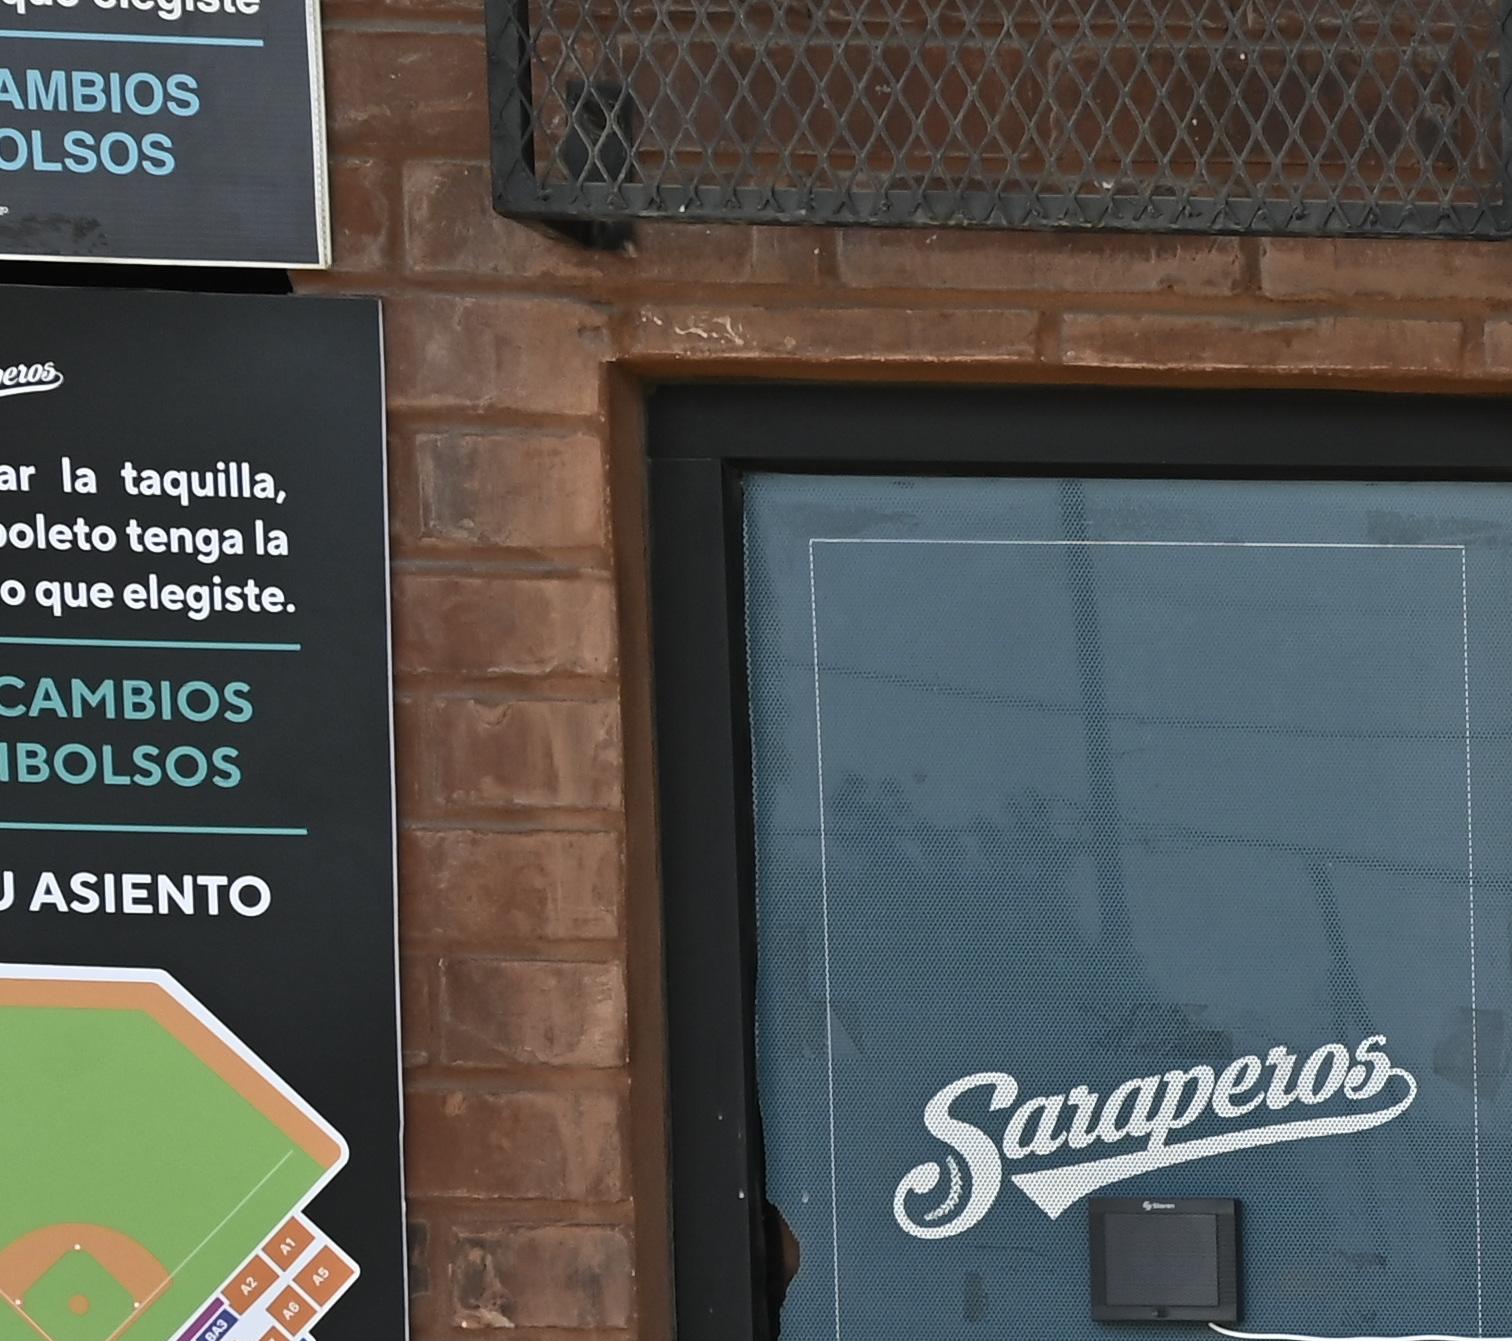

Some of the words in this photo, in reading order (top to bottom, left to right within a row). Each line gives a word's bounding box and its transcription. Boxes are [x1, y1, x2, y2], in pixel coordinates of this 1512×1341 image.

[61, 456, 98, 494] la
[120, 460, 287, 507] taquilla,
[0, 513, 117, 551] oleto
[125, 518, 244, 564] tenga
[254, 519, 289, 556] la
[35, 579, 114, 617] que
[123, 573, 296, 621] elegiste.
[0, 742, 242, 788] BOLSOS
[28, 871, 271, 917] ASIENTO
[893, 1034, 1417, 1239] Saraperos
[279, 1236, 296, 1256] A1
[239, 1276, 259, 1296] A2
[312, 1266, 330, 1287] A5
[282, 1301, 300, 1321] A6
